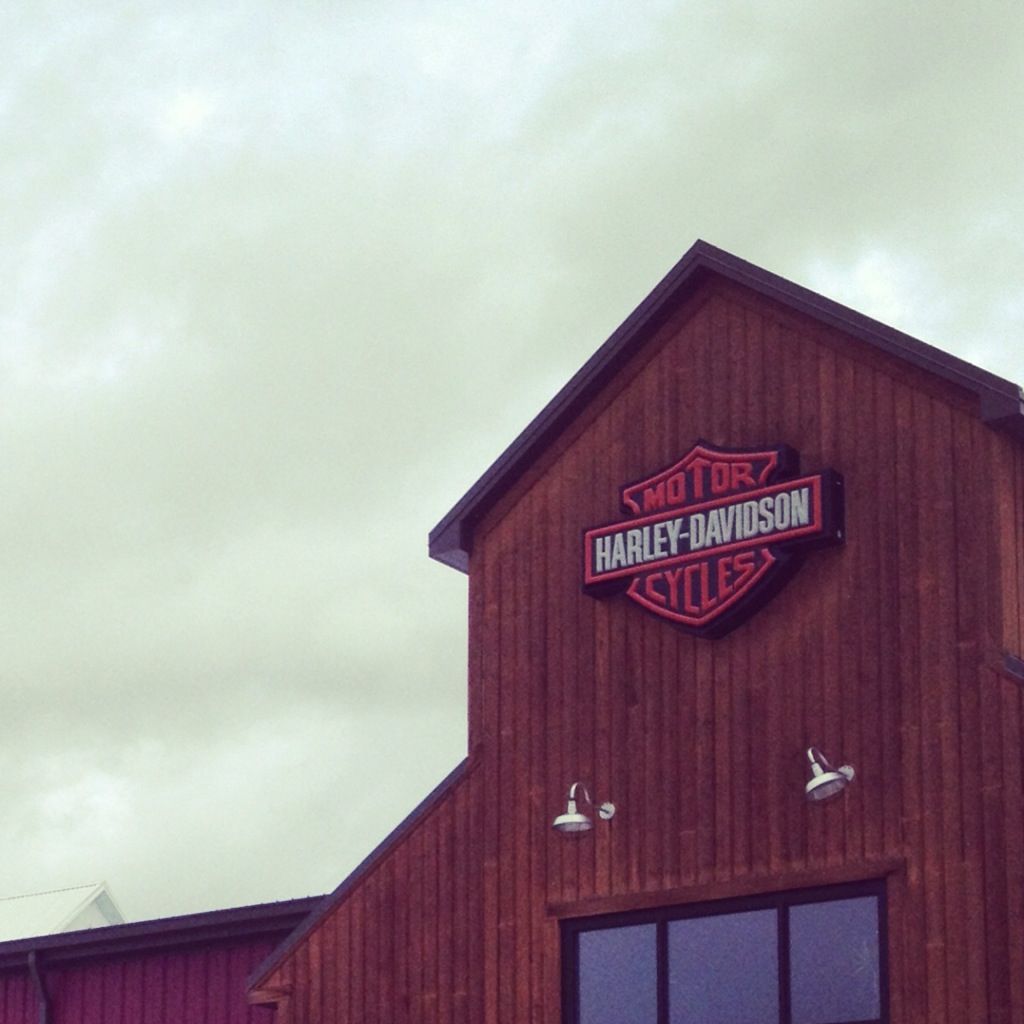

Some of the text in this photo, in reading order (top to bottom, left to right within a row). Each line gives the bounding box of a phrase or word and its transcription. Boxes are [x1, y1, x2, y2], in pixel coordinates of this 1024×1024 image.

[643, 457, 756, 512] MOTOR
[595, 486, 810, 574] HARLEY-DAVIDSON
[645, 551, 756, 615] CYCLES
